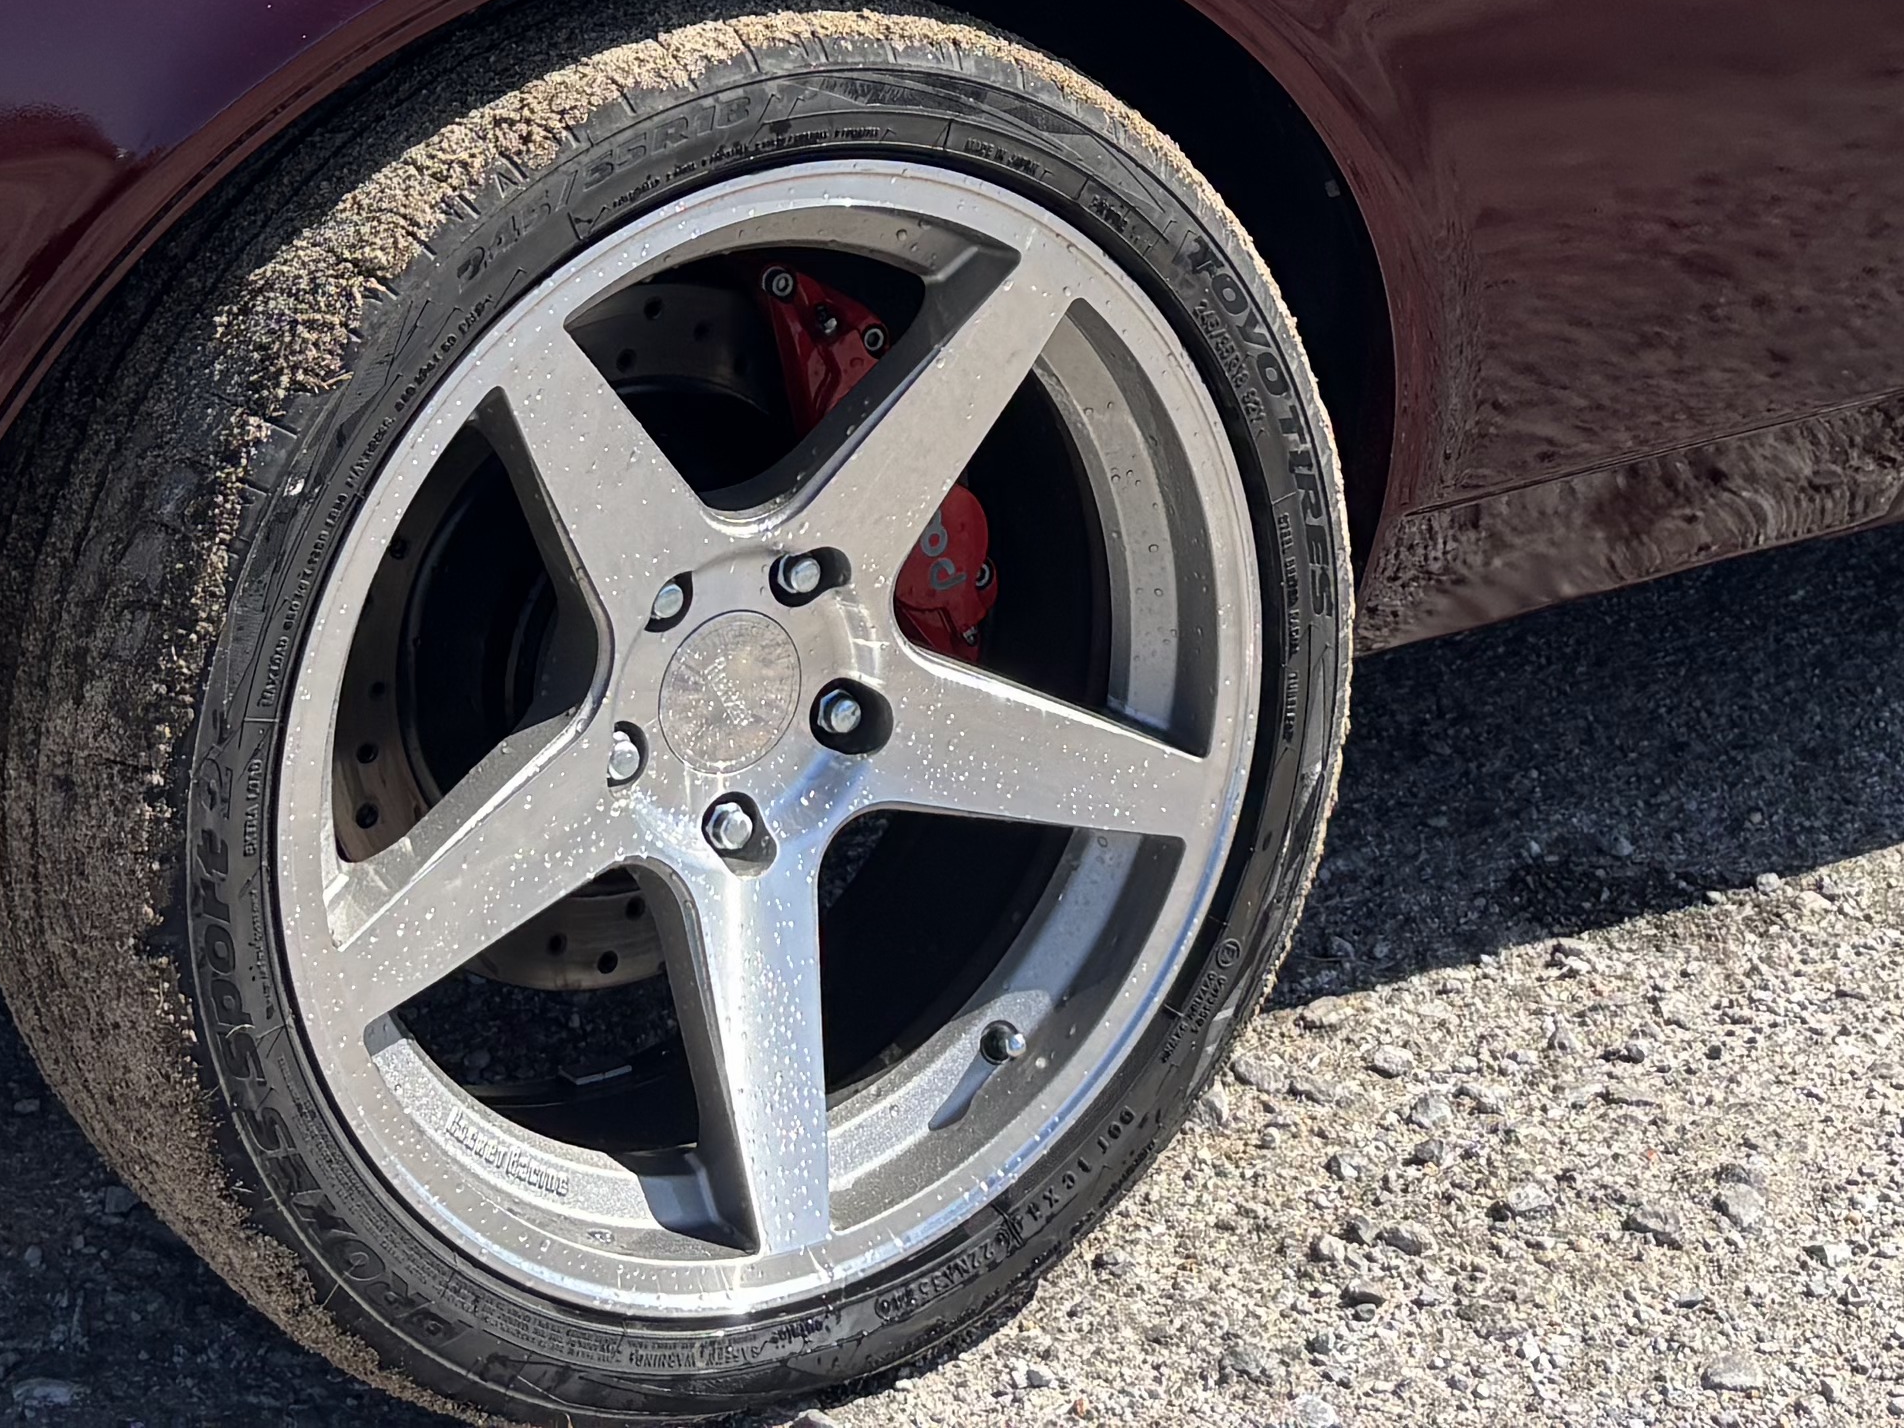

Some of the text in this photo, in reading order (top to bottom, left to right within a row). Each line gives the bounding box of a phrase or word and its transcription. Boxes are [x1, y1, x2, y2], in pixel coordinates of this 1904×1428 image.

[1181, 231, 1333, 622] TOYO TIRES
[194, 823, 271, 1103] Sport
